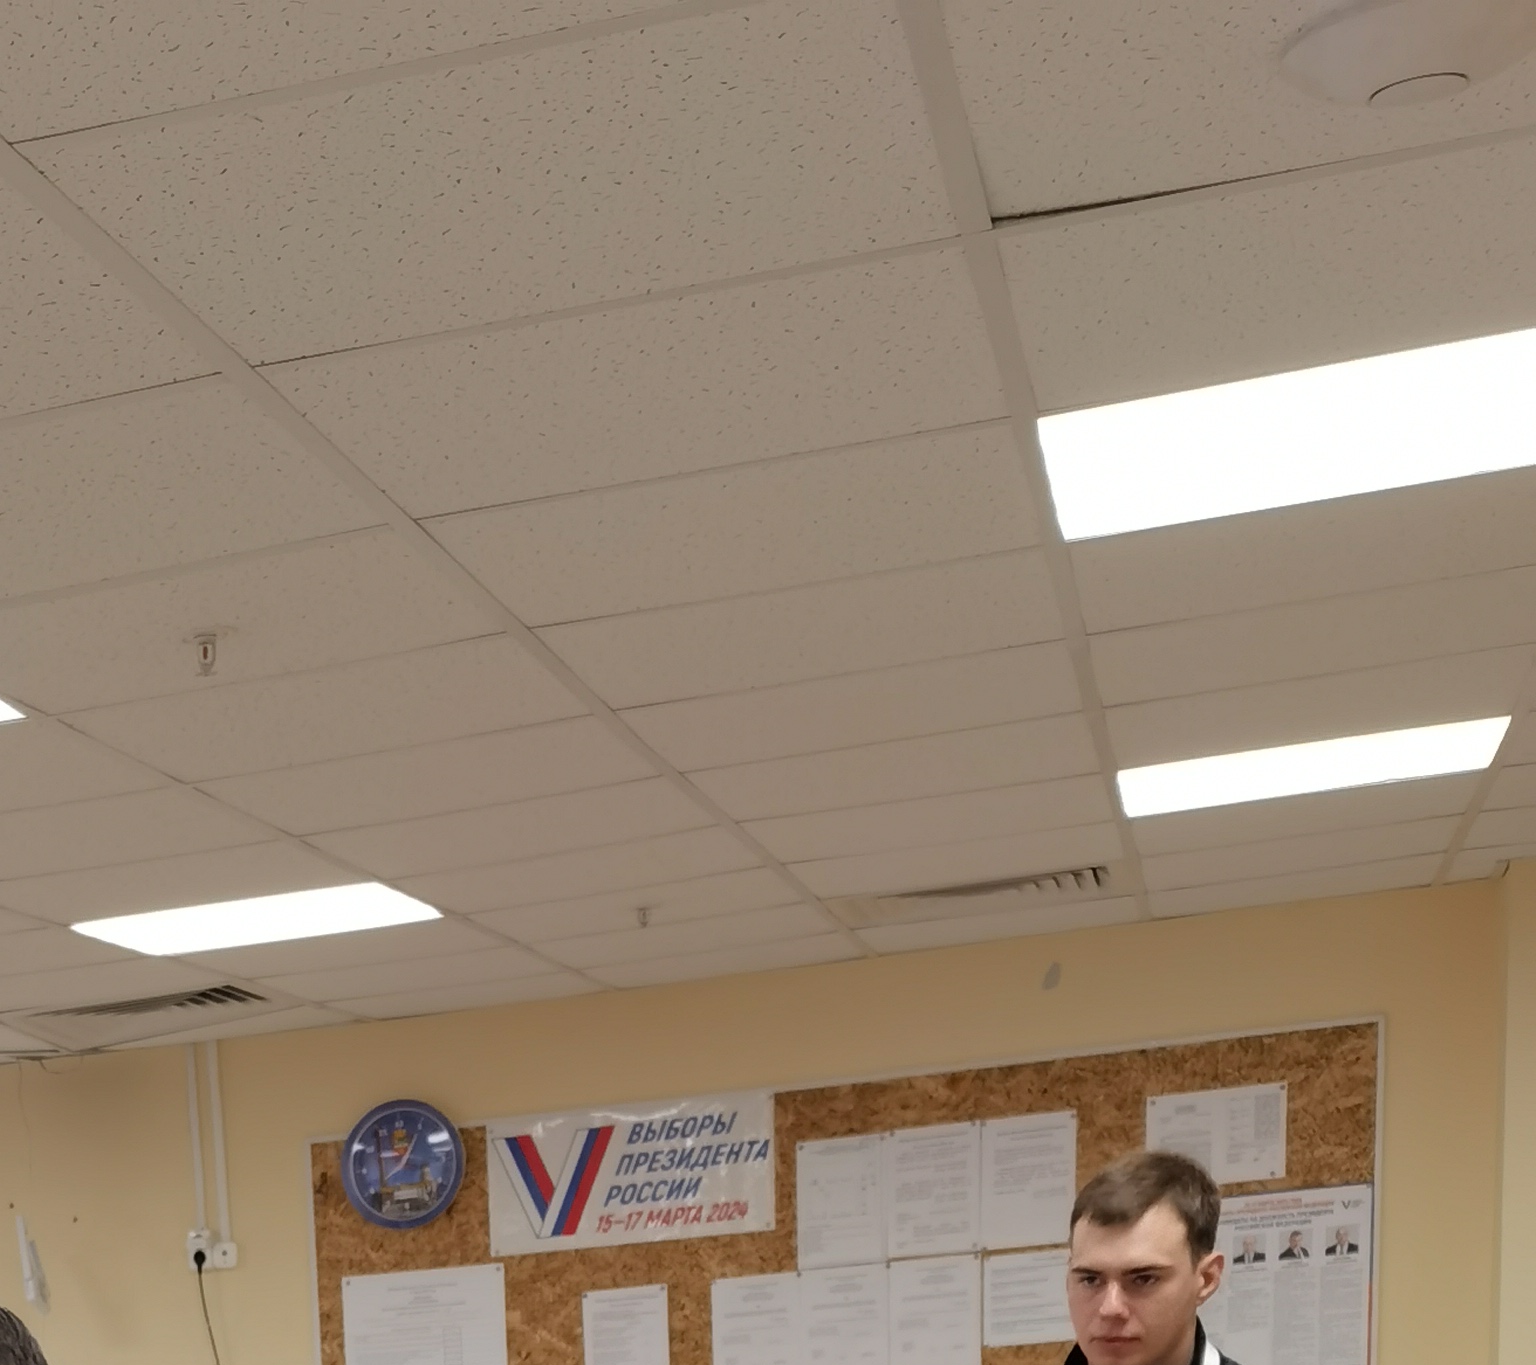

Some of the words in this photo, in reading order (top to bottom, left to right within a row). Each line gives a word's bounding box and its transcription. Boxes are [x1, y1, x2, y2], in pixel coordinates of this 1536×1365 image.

[627, 1111, 737, 1145] ВЫБОРЫ
[615, 1139, 770, 1176] ПРЕЗИДЕНТА
[604, 1176, 702, 1208] РОССИИ
[644, 1204, 704, 1229] МАРТА
[706, 1200, 749, 1224] 2024
